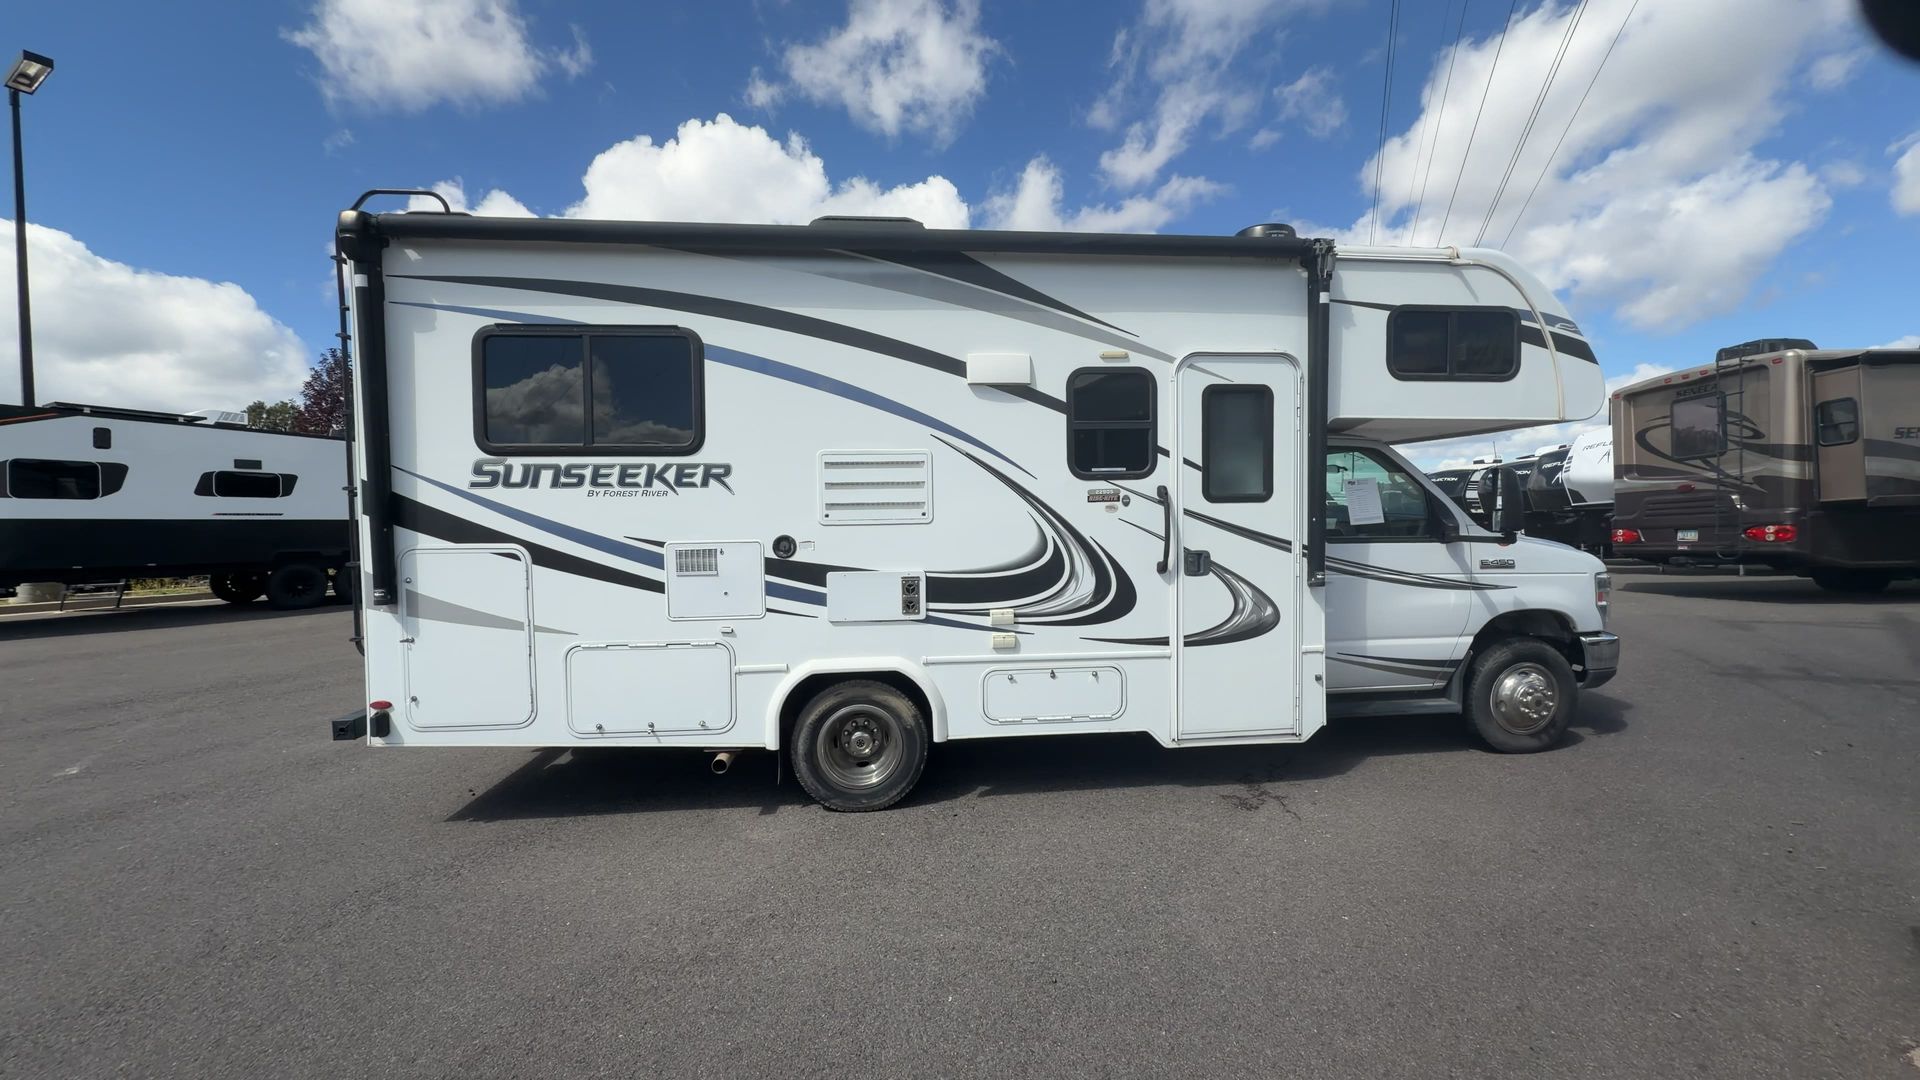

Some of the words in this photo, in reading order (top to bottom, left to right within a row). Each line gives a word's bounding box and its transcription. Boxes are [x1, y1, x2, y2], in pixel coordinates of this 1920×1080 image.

[468, 457, 736, 496] SUNSEEKER
[587, 489, 601, 497] BY
[602, 489, 639, 498] FOREST
[641, 489, 669, 497] RIVER
